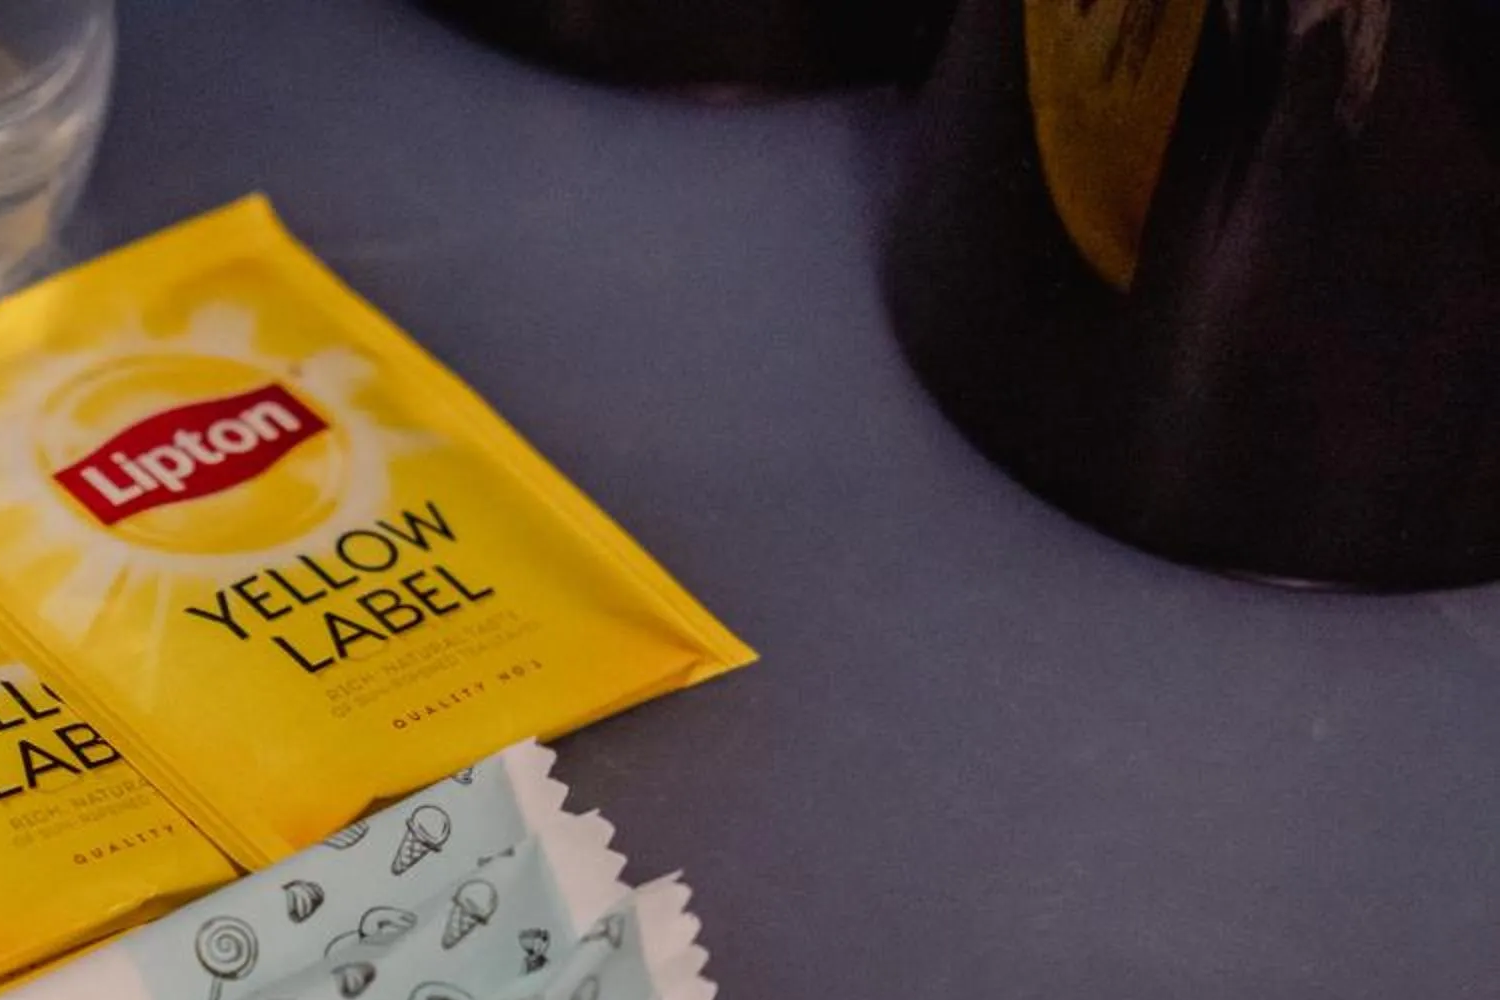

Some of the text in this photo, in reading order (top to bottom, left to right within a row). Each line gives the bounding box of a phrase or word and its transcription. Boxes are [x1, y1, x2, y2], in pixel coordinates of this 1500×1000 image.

[81, 400, 301, 508] Lipton
[184, 501, 457, 641] YELLOW
[272, 565, 495, 674] LABEL
[392, 682, 485, 729] QUALITY
[72, 778, 151, 808] NATURA
[73, 824, 174, 865] QUALITY
